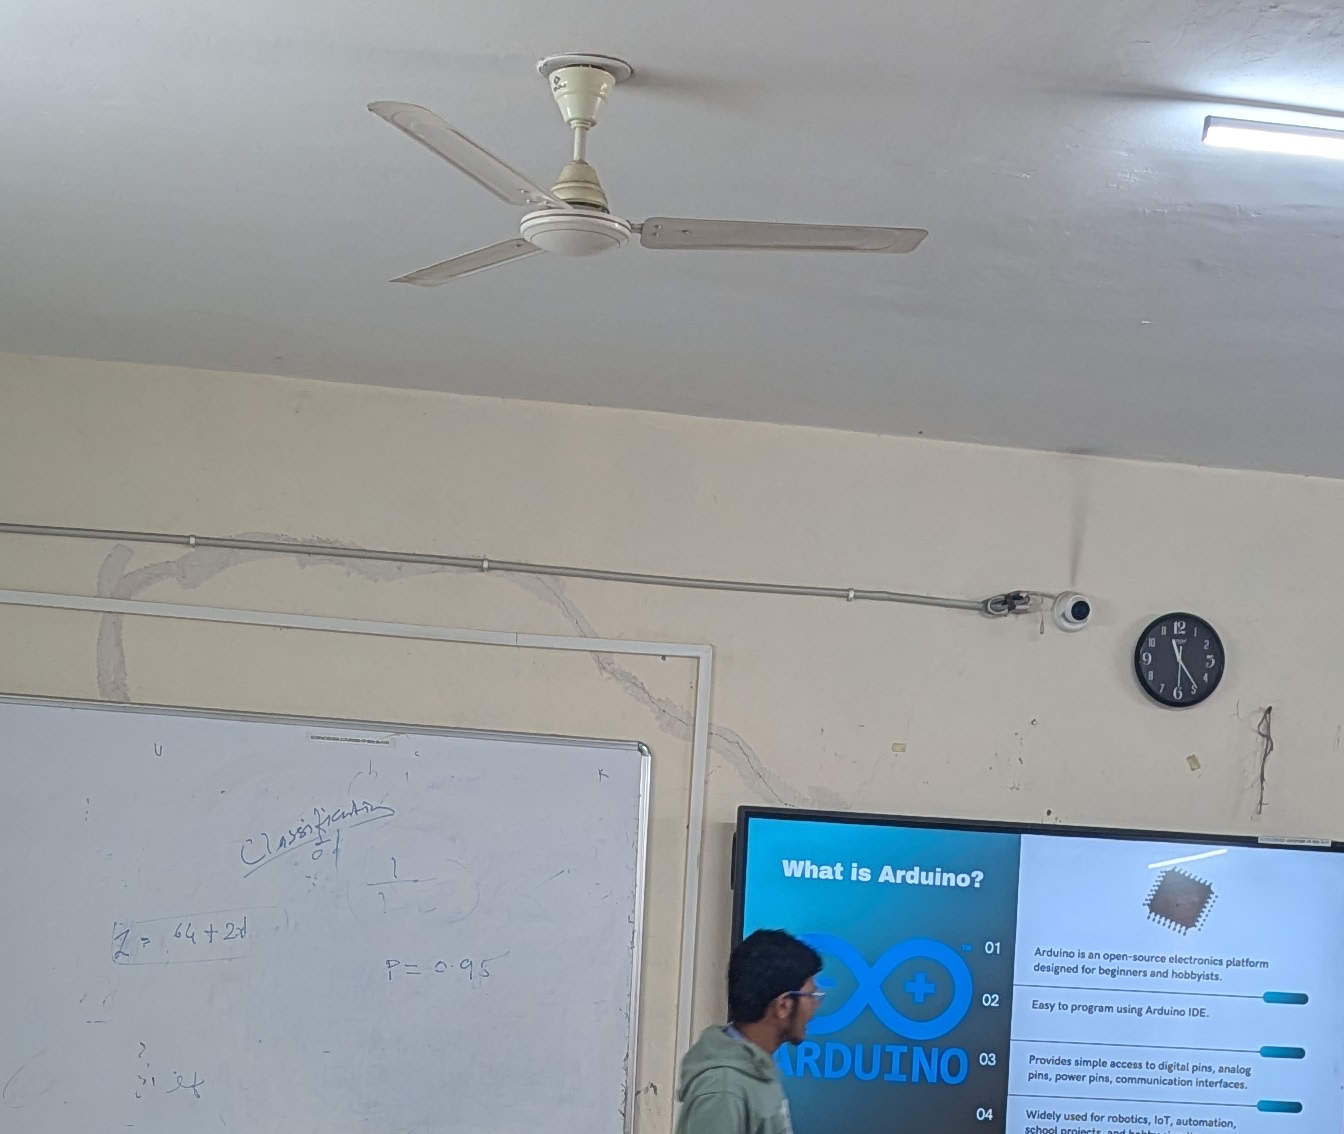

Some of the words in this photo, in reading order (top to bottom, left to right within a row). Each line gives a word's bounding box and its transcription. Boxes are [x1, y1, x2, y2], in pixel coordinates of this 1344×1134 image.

[1174, 621, 1186, 634] 12
[1194, 627, 1197, 636] 1
[1149, 638, 1155, 647] 10
[1204, 640, 1210, 649] 2
[1142, 653, 1151, 665] 9
[1206, 655, 1215, 668] 3
[1203, 673, 1207, 682] 4
[1160, 684, 1164, 693] 7
[1173, 686, 1182, 699] 6
[783, 860, 843, 881] What
[851, 862, 871, 882] is
[878, 865, 984, 888] Arduino?
[985, 941, 1001, 955] 01
[1034, 947, 1075, 958] Arduino
[1077, 950, 1086, 959] is
[1088, 951, 1100, 960] an
[1103, 951, 1166, 963] open-source
[1169, 955, 1223, 966] electronics
[1226, 957, 1269, 970] platform
[1034, 963, 1078, 977] designed
[1081, 964, 1096, 975] for
[1099, 966, 1147, 979] beginners
[1150, 967, 1168, 978] and
[1171, 968, 1222, 982] hobbyists.
[982, 994, 999, 1007] 02
[1032, 1000, 1055, 1012] Easy
[1058, 1001, 1068, 1011] to
[1071, 1004, 1113, 1016] program
[1116, 1004, 1143, 1016] using
[1145, 1005, 1185, 1017] Arduino
[1188, 1008, 1209, 1018] IDE.
[773, 1041, 969, 1085] ARDUINO
[980, 1053, 996, 1066] 03
[1029, 1055, 1072, 1067] Provides
[1074, 1057, 1107, 1069] simple
[1110, 1061, 1142, 1069] access
[1145, 1061, 1156, 1070] to
[1158, 1061, 1189, 1073] digital
[1192, 1064, 1216, 1074] pins,
[1218, 1065, 1251, 1077] analog
[1028, 1071, 1052, 1082] pins,
[1055, 1074, 1086, 1083] power
[1089, 1073, 1112, 1084] pins,
[1115, 1074, 1193, 1087] communication
[1195, 1078, 1247, 1090] interfaces.
[976, 1108, 993, 1121] 04
[1026, 1110, 1061, 1122] Widely
[1063, 1112, 1088, 1122] used
[1090, 1113, 1105, 1123] for
[1107, 1113, 1151, 1125] robotics,
[1154, 1116, 1173, 1126] IoT,
[1176, 1118, 1236, 1129] automation,
[1025, 1126, 1057, 1134] school
